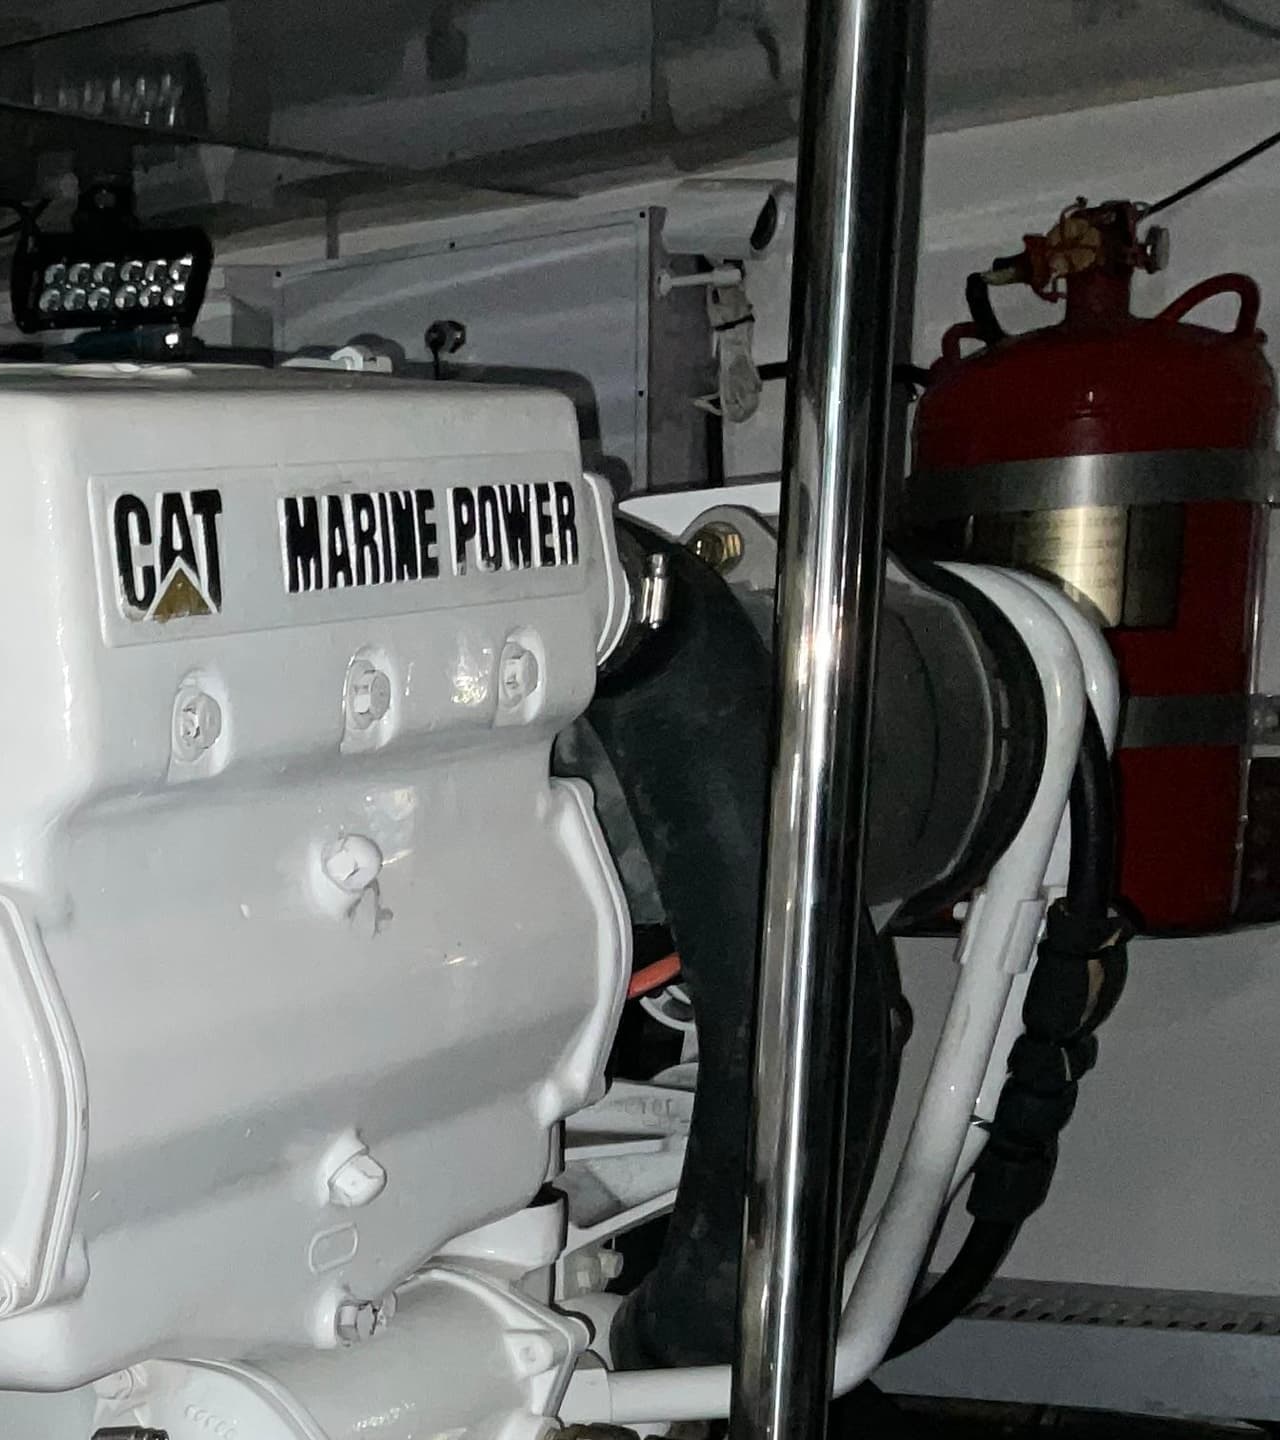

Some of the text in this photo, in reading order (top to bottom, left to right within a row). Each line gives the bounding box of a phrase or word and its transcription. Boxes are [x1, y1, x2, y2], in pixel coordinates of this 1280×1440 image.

[114, 481, 579, 613] CAT MARINE POWER
